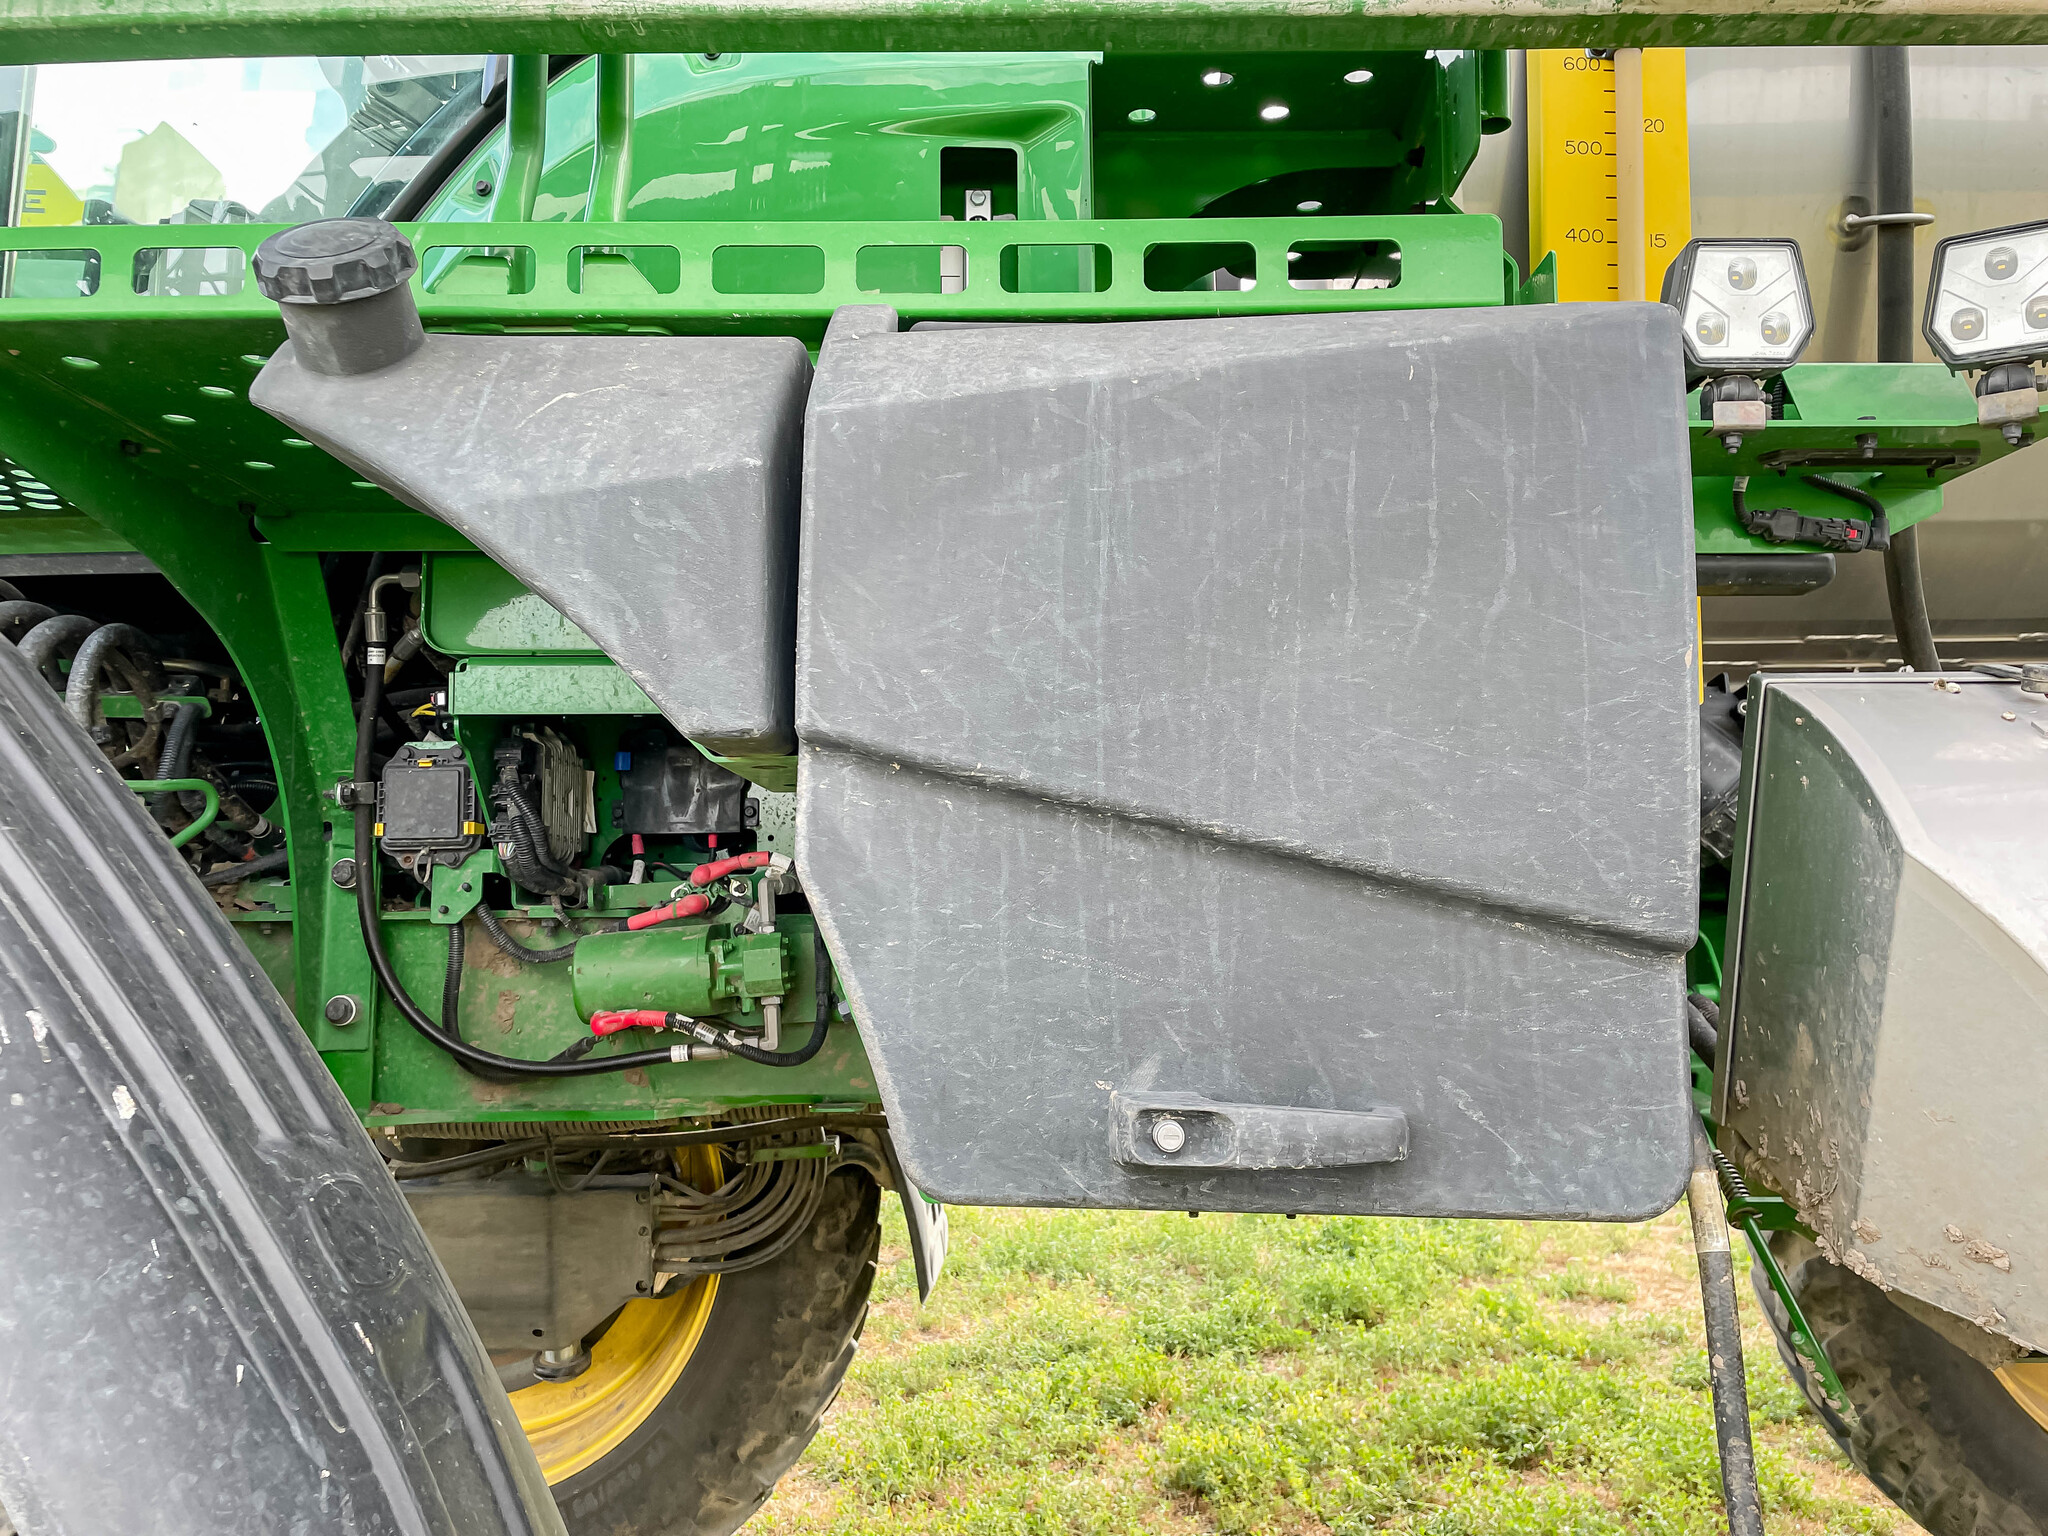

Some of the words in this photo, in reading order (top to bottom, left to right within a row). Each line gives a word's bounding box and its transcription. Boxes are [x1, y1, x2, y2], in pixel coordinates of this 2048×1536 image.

[1563, 56, 1601, 72] 600
[1643, 118, 1665, 133] 20
[1564, 140, 1603, 155] 500
[1565, 228, 1604, 243] 400
[1649, 233, 1667, 248] 15
